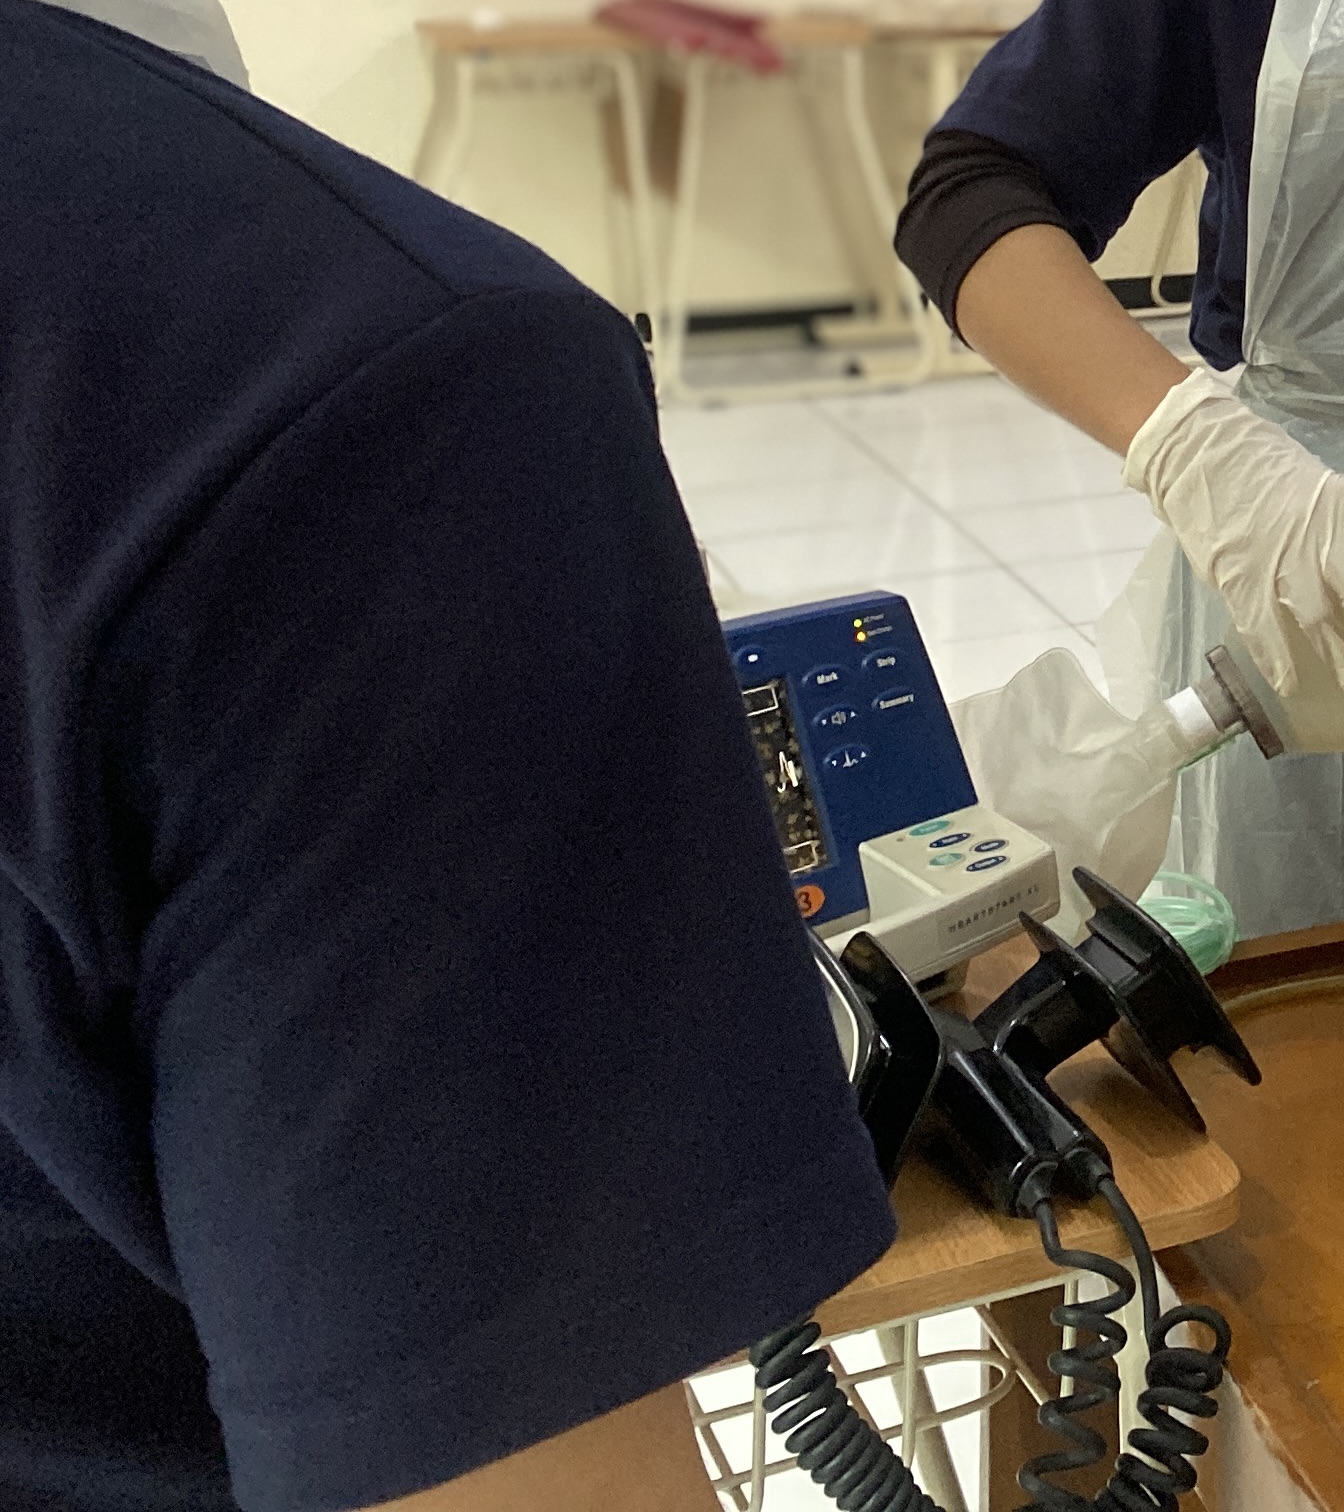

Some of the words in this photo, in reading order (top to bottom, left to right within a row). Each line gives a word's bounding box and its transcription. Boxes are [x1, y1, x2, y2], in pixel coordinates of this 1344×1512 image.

[876, 656, 896, 667] Strip
[817, 672, 838, 684] Mark
[880, 694, 914, 709] Summary
[798, 891, 812, 913] 3
